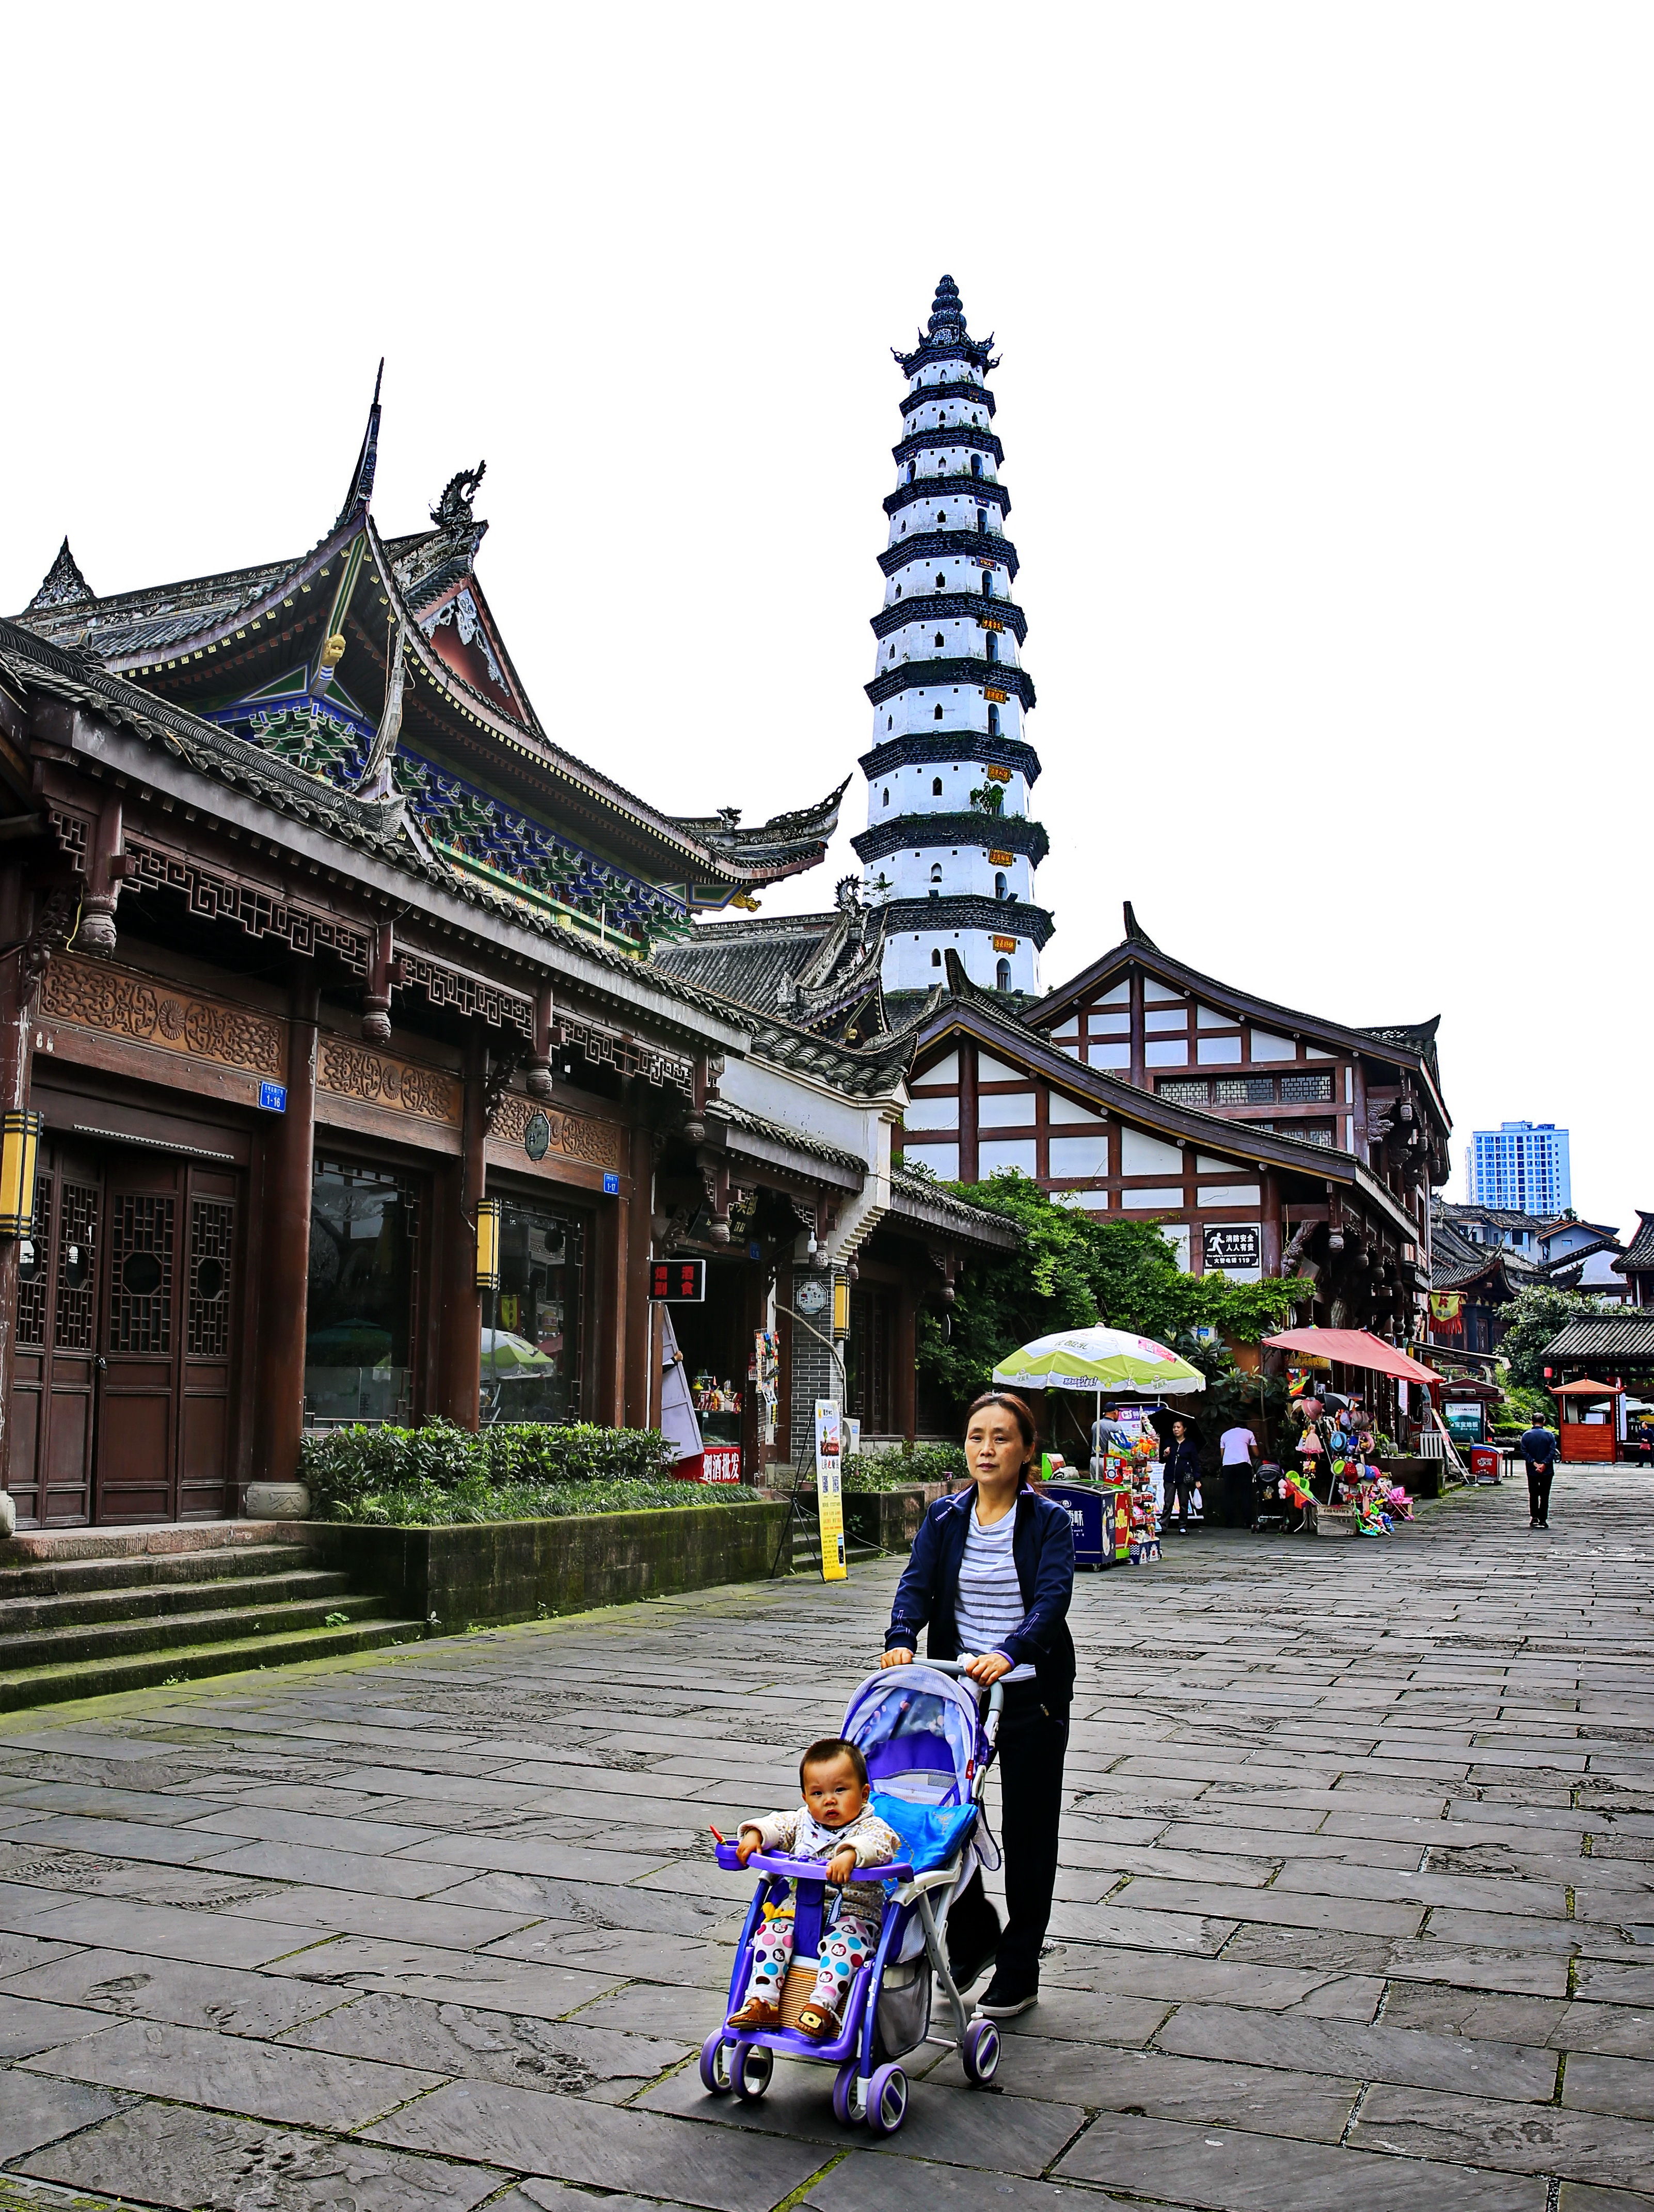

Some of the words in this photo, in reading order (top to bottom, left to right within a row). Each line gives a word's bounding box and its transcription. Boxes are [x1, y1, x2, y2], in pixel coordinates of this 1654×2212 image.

[266, 1094, 280, 1108] 1-16
[607, 1183, 616, 1191] 1-17
[1226, 1234, 1254, 1243] 消防安全
[1226, 1243, 1254, 1252] 人人有责
[703, 1452, 739, 1481] 烟酒批发
